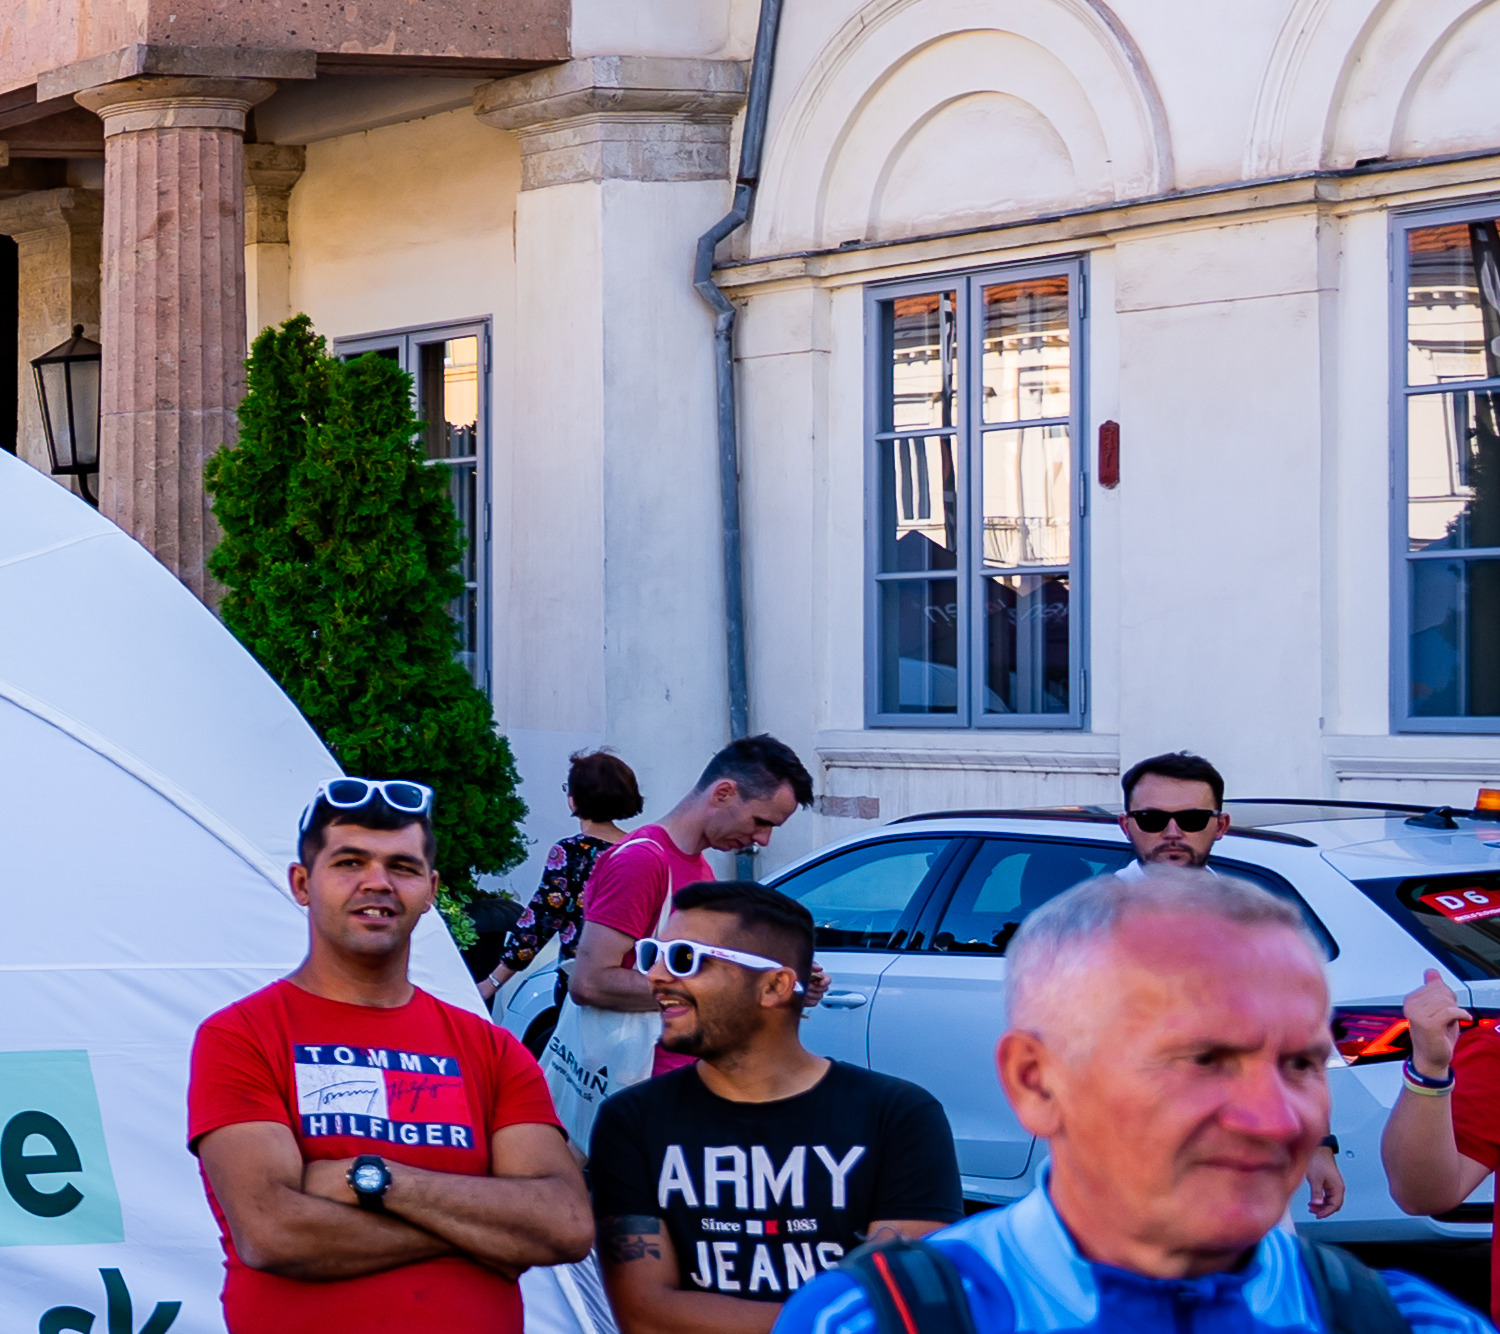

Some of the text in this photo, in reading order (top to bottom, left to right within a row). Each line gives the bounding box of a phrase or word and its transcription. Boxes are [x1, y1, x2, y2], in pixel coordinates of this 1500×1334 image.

[1434, 895, 1466, 910] D
[304, 1046, 449, 1076] TOMMY
[548, 1036, 608, 1096] GARMIN
[309, 1115, 470, 1149] HILFIGER
[657, 1144, 867, 1210] ARMY
[700, 1217, 741, 1233] Since
